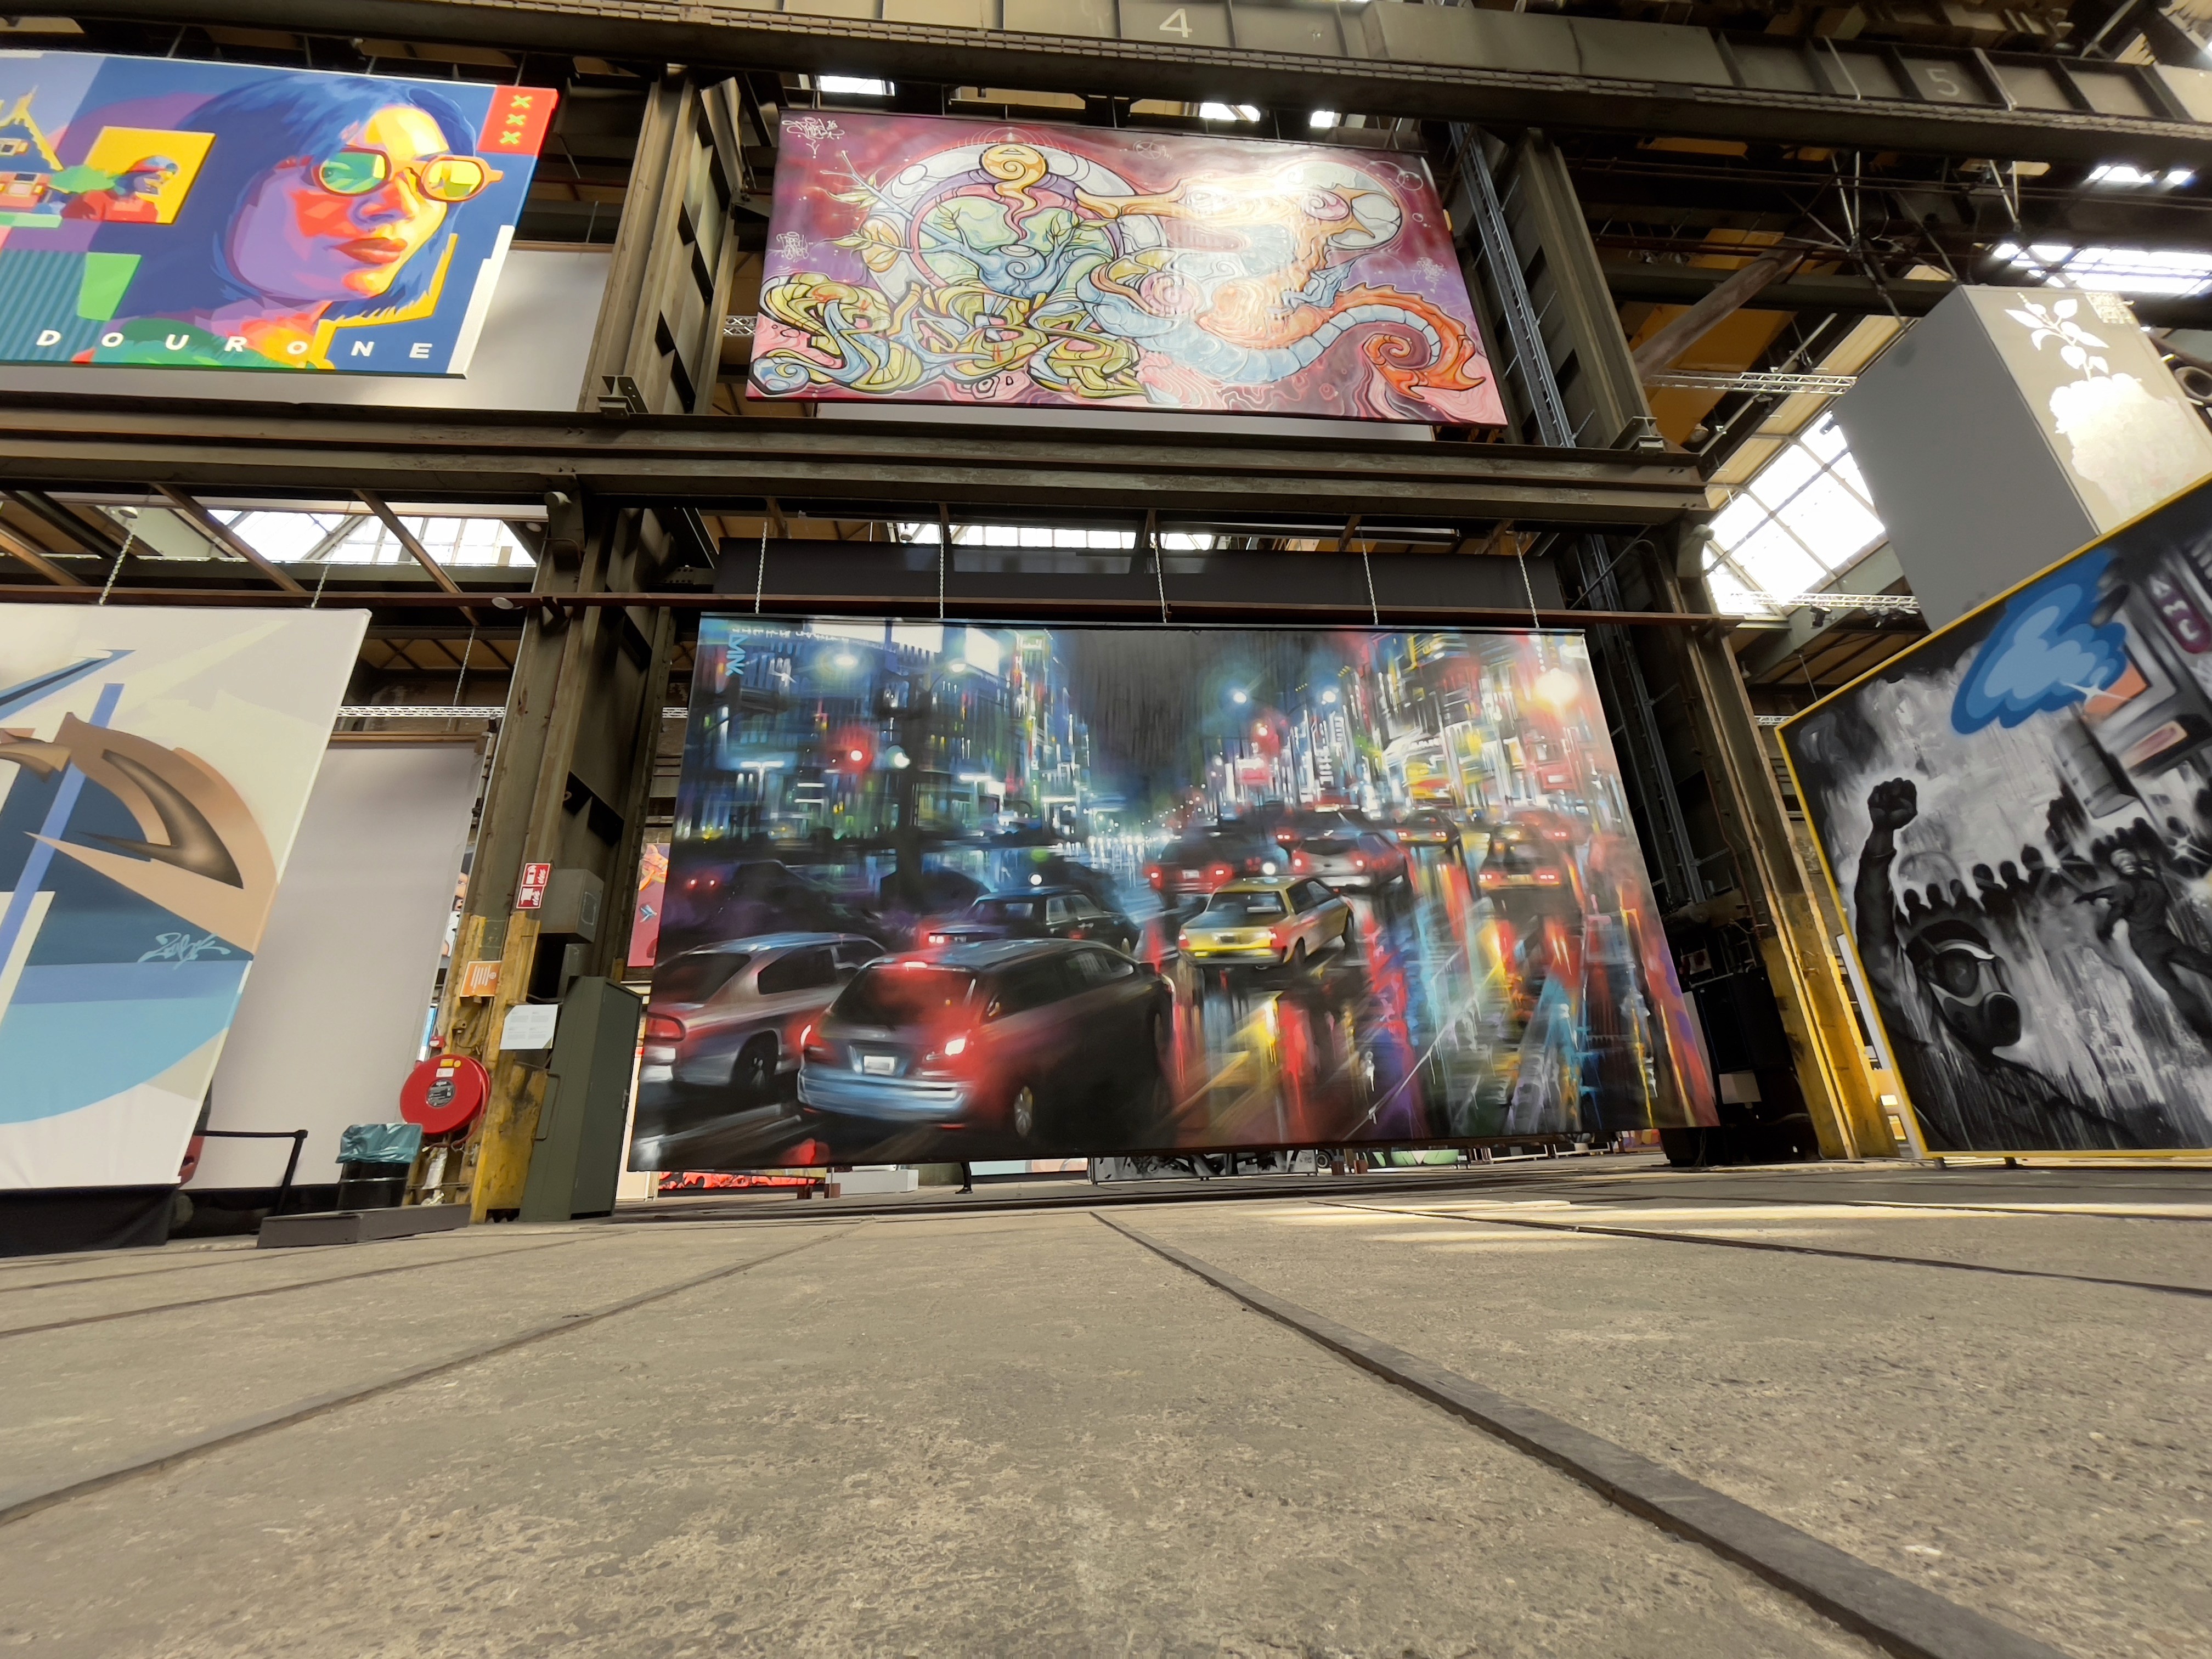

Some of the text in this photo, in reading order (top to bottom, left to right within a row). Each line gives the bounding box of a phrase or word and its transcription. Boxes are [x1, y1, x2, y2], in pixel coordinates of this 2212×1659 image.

[1159, 8, 1193, 38] 4
[1925, 68, 1960, 97] 5
[36, 329, 433, 359] DOURONE
